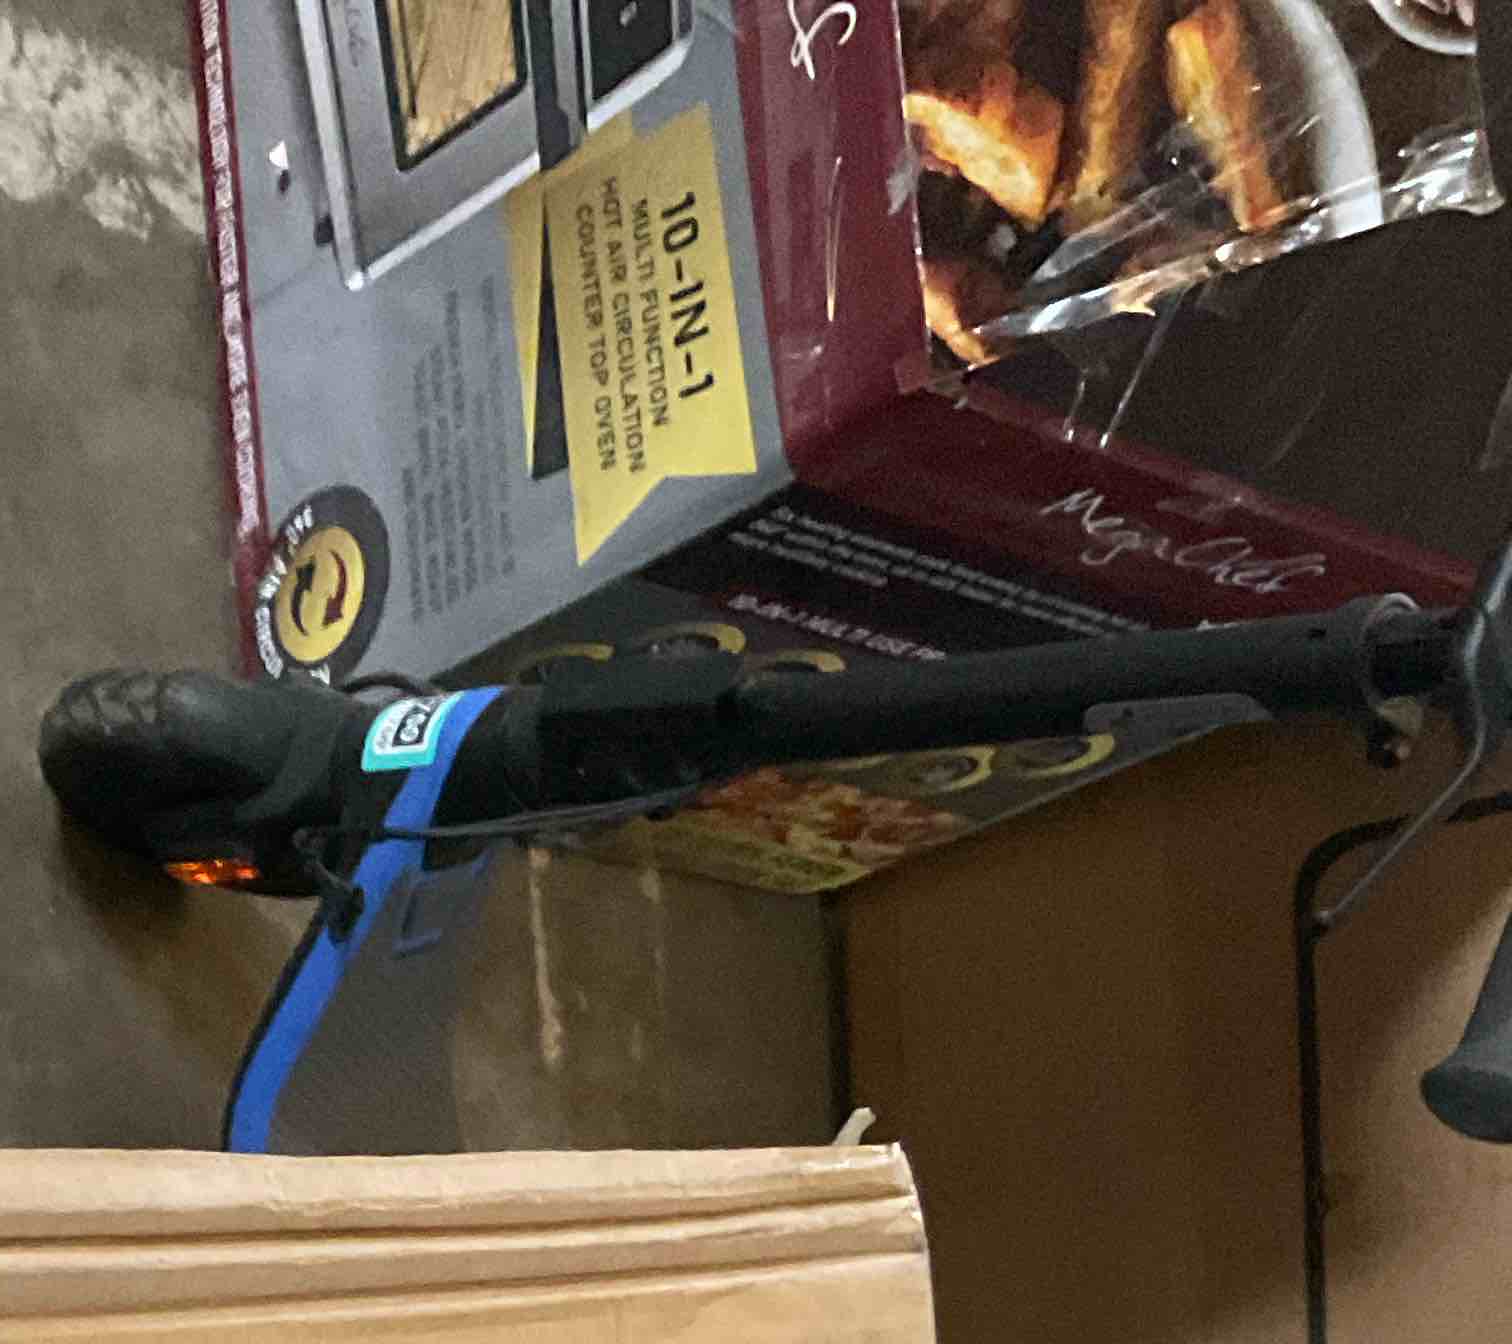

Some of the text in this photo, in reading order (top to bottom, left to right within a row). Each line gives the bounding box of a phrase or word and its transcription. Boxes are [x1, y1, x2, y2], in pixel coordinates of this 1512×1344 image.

[575, 204, 618, 472] COUNTER TOP OVEN
[600, 177, 648, 473] HOT AIR CIRCULATION
[630, 198, 671, 426] MULTI FUNCTION
[661, 192, 715, 399] 10-IN-1
